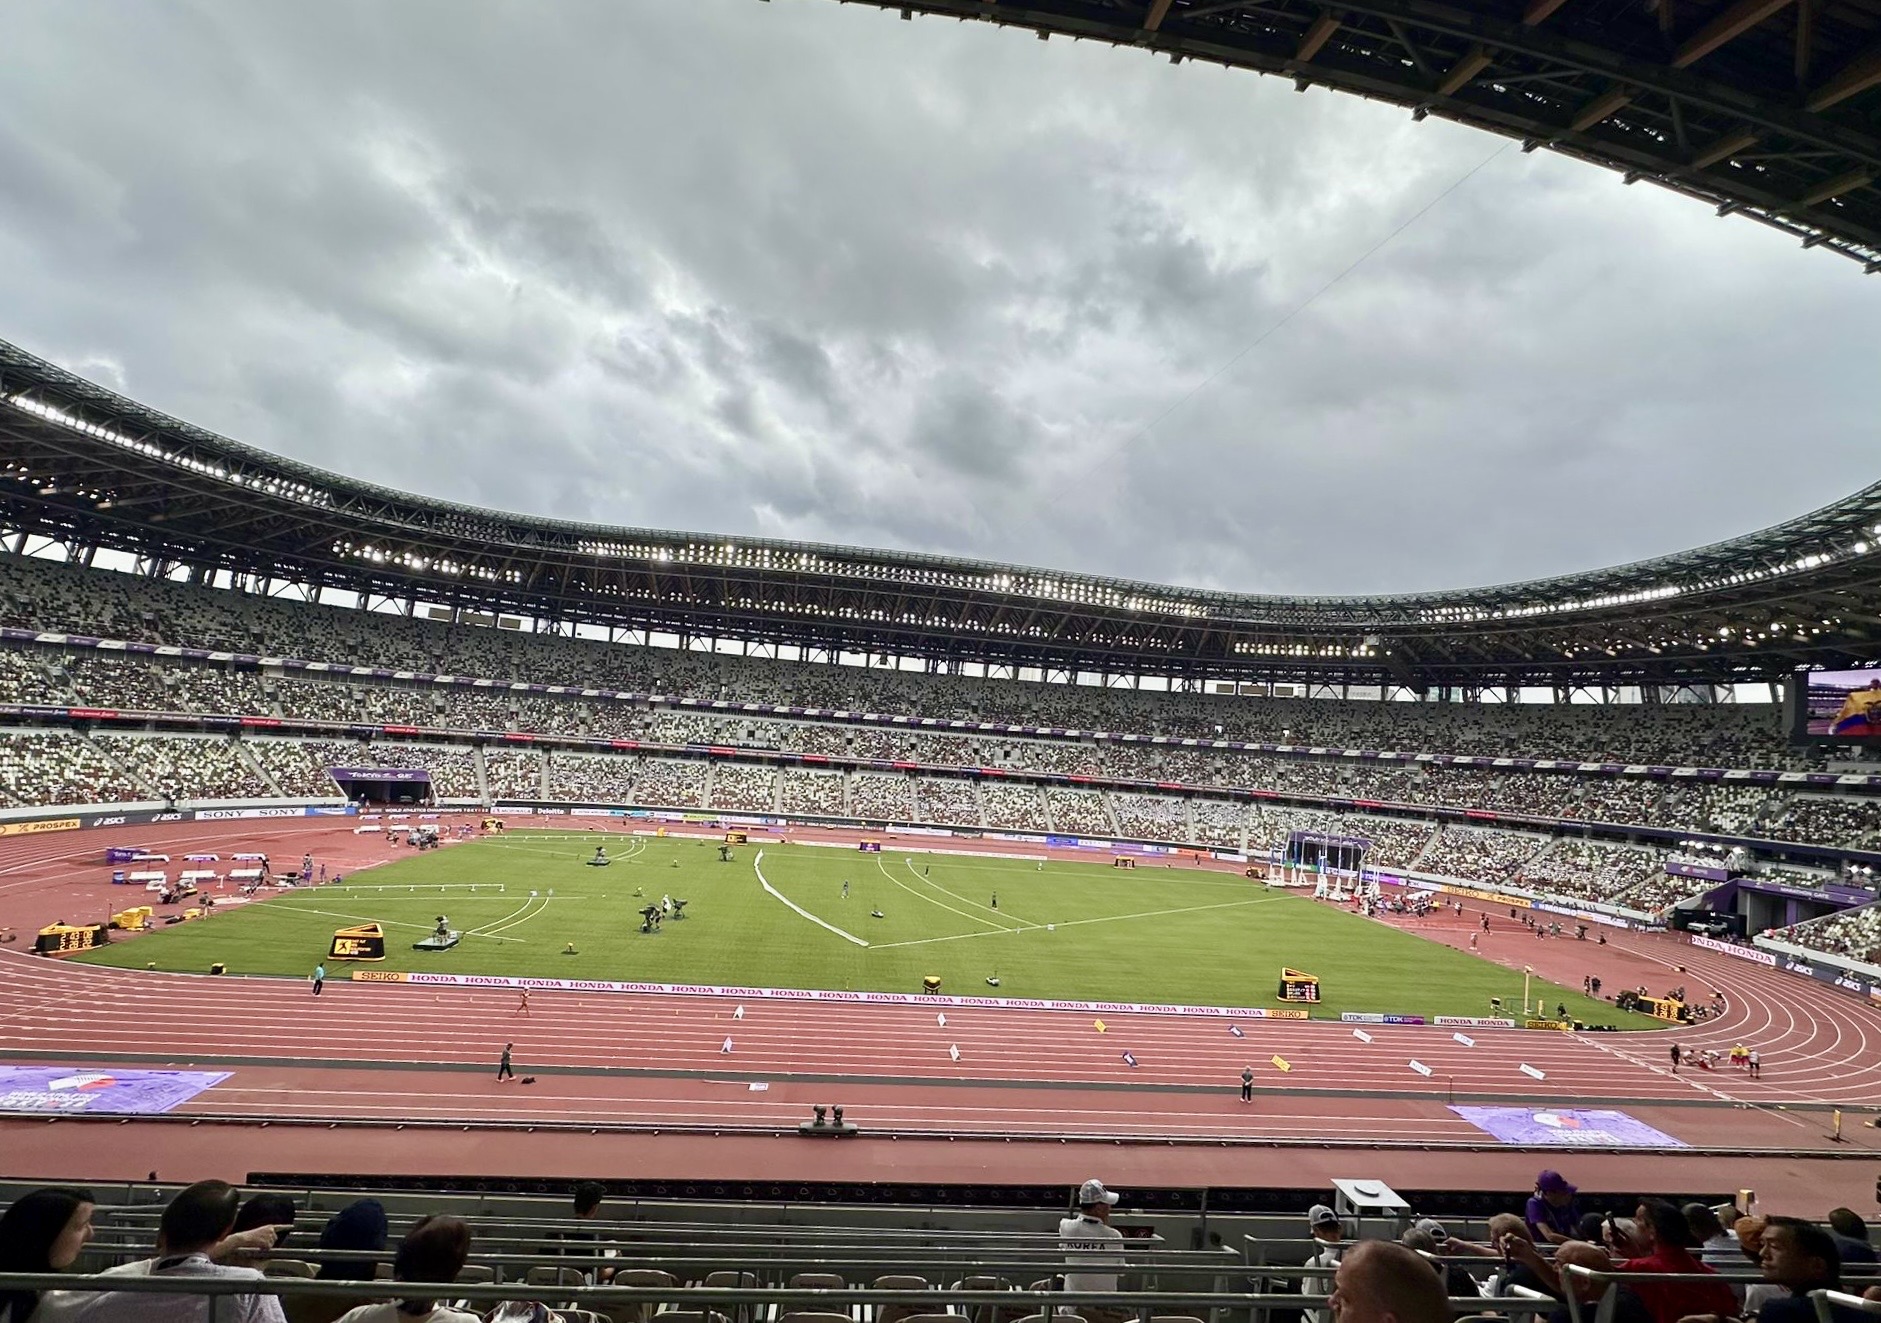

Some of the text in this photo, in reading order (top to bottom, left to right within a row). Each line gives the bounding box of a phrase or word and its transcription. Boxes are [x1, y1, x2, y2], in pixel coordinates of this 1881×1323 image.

[203, 810, 245, 818] SONY
[259, 808, 299, 816] SONY
[33, 821, 78, 831] PROSPEX
[1447, 886, 1480, 898] SEIKO
[1727, 944, 1773, 963] HONDA
[361, 971, 400, 981] SEIKO
[411, 974, 459, 983] HONDA
[465, 976, 510, 985] HONDA
[518, 979, 562, 988] HONDA
[569, 981, 614, 990] HONDA
[621, 983, 664, 992] HONDA
[671, 985, 714, 994] HONDA
[721, 988, 764, 996] HONDA
[770, 990, 812, 998] HONDA
[818, 992, 860, 1000] HONDA
[866, 993, 907, 1001] HONDA
[913, 996, 954, 1004] HONDA
[960, 997, 1000, 1005] HONDA
[1051, 1001, 1090, 1009] HONDA
[1095, 1003, 1133, 1011] HONDA
[1139, 1005, 1177, 1013] HONDA
[1183, 1007, 1220, 1015] HONDA
[1271, 1010, 1301, 1018] SEIKO
[1477, 1018, 1510, 1027] HONDA
[1527, 1021, 1558, 1029] SEIKO
